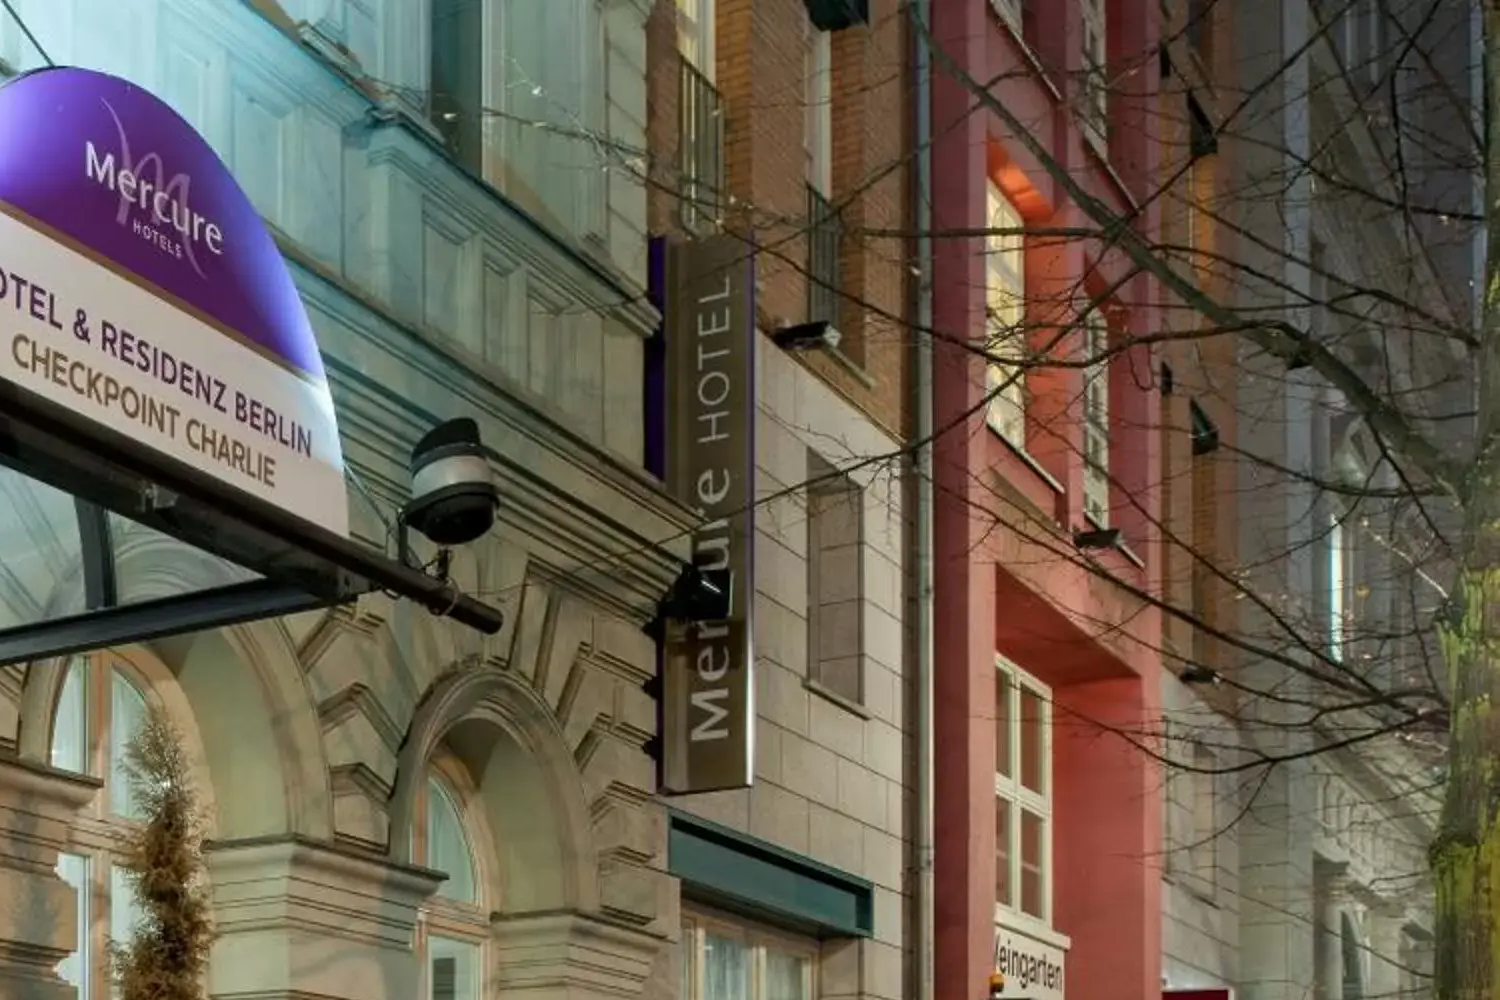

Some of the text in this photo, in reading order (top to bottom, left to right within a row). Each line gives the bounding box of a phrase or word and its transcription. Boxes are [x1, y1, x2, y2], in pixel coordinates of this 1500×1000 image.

[85, 141, 224, 255] Mercure
[133, 220, 182, 259] HOTELS
[11, 333, 276, 488] CHECKPOINT CHARLIE
[73, 308, 91, 345] &
[101, 320, 228, 414] RESIDENZ
[235, 393, 313, 458] BERLIN
[691, 276, 731, 741] Merure HOTEL
